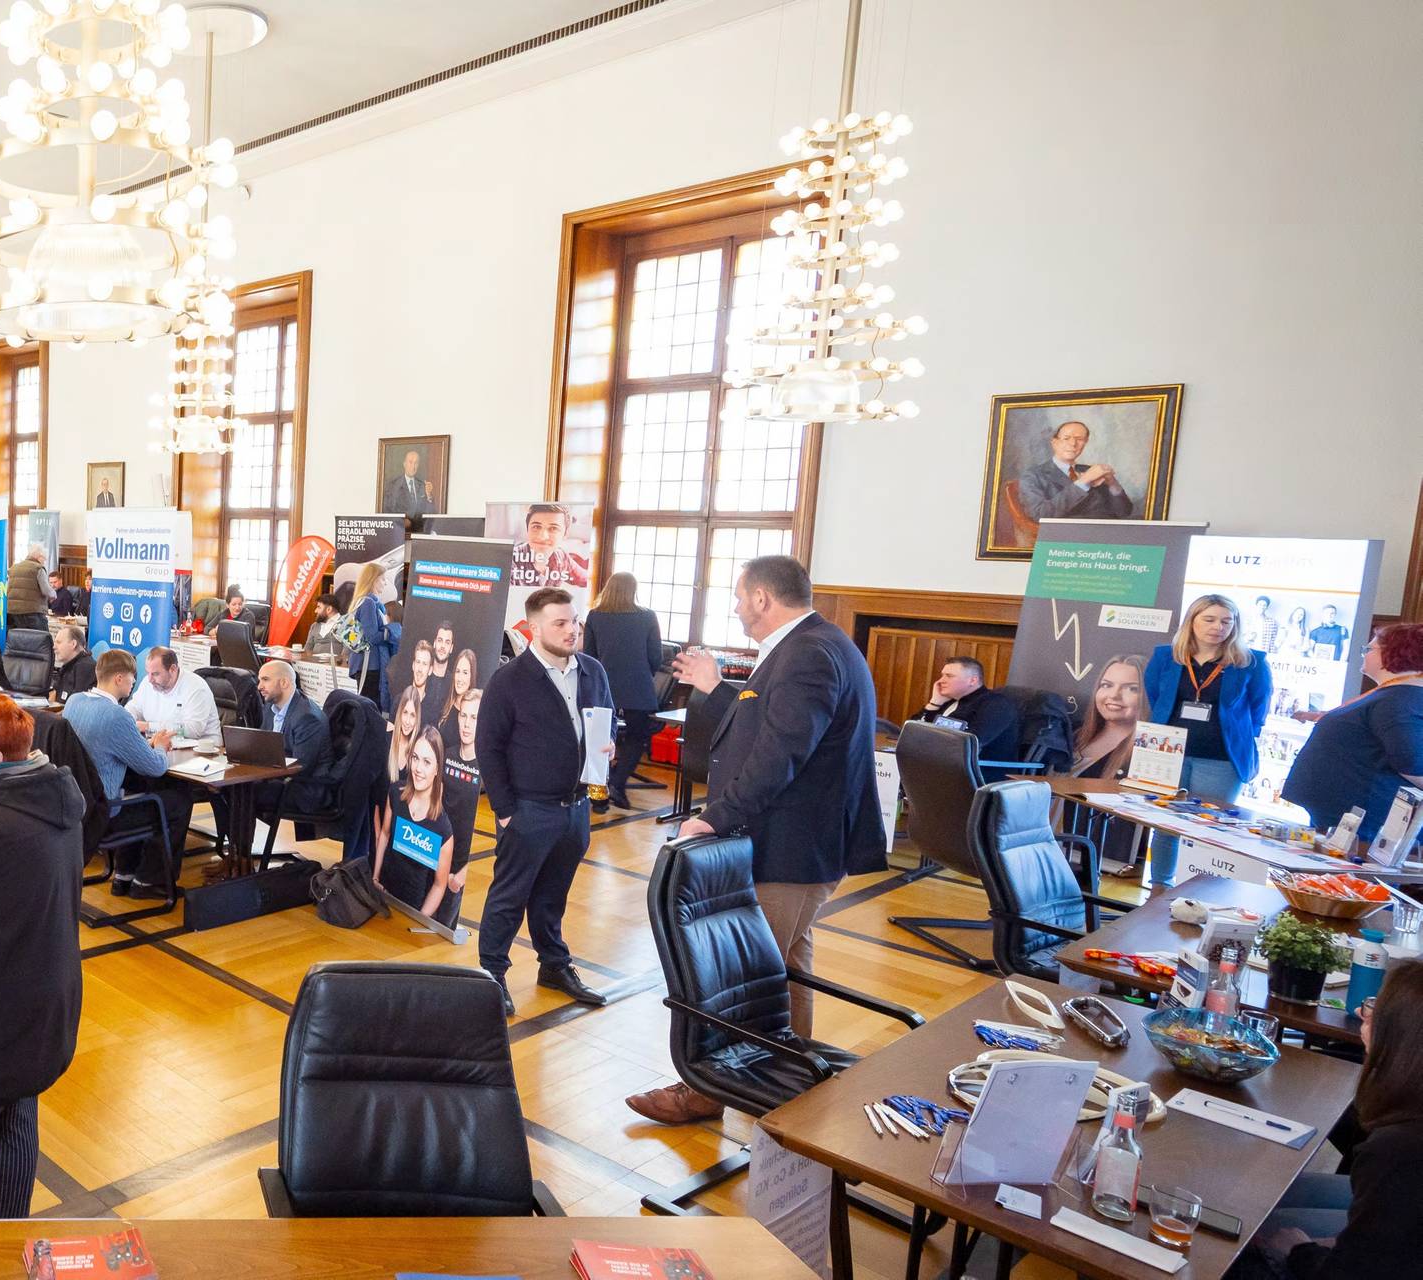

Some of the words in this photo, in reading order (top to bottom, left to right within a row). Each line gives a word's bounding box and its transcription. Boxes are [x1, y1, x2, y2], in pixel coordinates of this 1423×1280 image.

[95, 537, 170, 560] Vollmann
[337, 542, 347, 550] DIN
[348, 543, 366, 551] NEXT.
[1048, 549, 1075, 558] Meine
[1077, 550, 1113, 561] Sorgfalt,
[1116, 552, 1131, 560] die
[1225, 555, 1261, 566] LUTZ
[145, 565, 170, 576] Group
[1046, 559, 1078, 569] Energie
[1079, 561, 1092, 569] ins
[1094, 562, 1117, 570] Haus
[1119, 563, 1150, 573] bringt.
[513, 566, 539, 583] tig,
[545, 566, 574, 581] los.
[1271, 661, 1290, 672] MIT
[1294, 664, 1318, 675] UNS
[402, 825, 433, 853] Debeka
[1211, 858, 1236, 873] LUTZ
